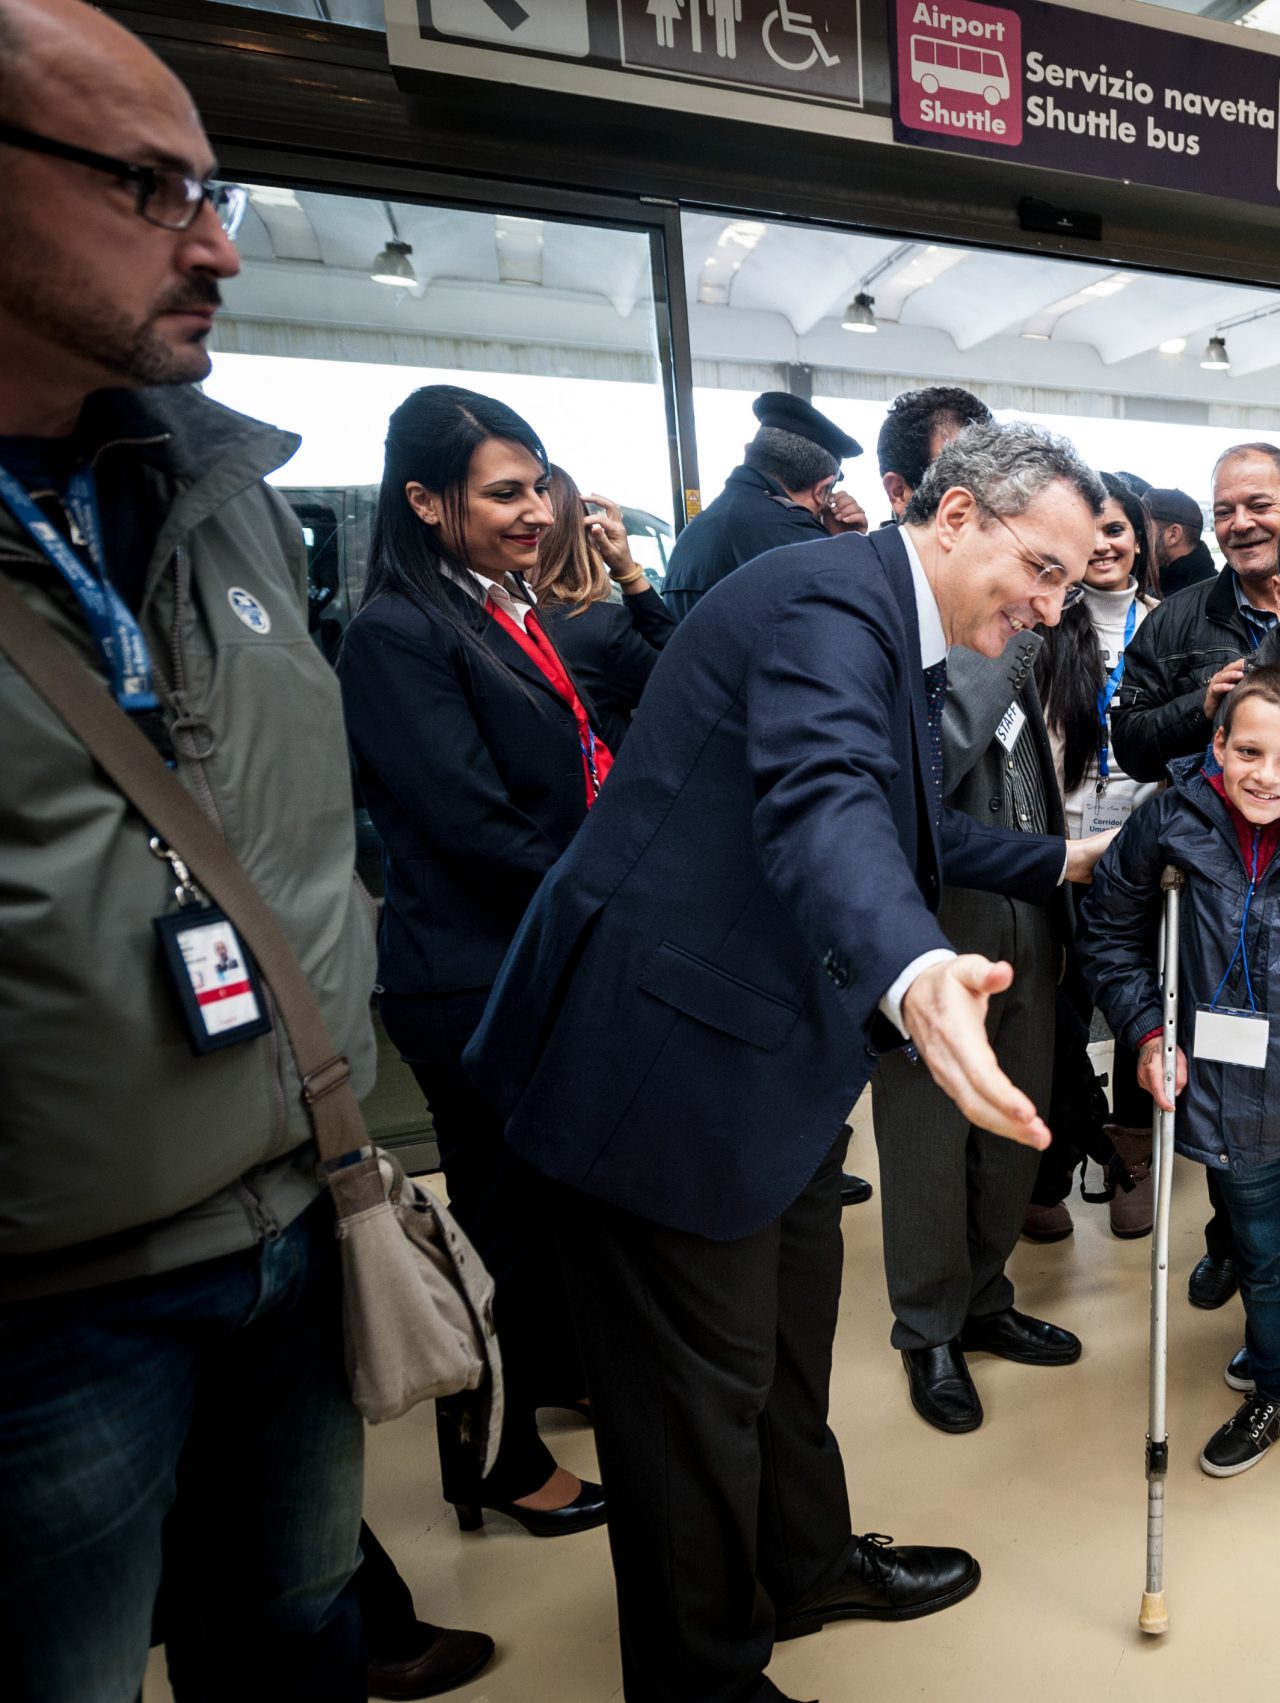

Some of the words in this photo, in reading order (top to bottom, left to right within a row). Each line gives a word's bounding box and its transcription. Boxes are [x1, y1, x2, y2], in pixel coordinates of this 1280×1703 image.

[912, 2, 1005, 41] Airport
[1025, 51, 1154, 105] Servizio
[1164, 88, 1275, 129] navetta
[919, 98, 1007, 135] Shuttle
[1026, 95, 1137, 143] Shuttle
[1147, 116, 1200, 155] bus
[998, 706, 1017, 741] STAFF
